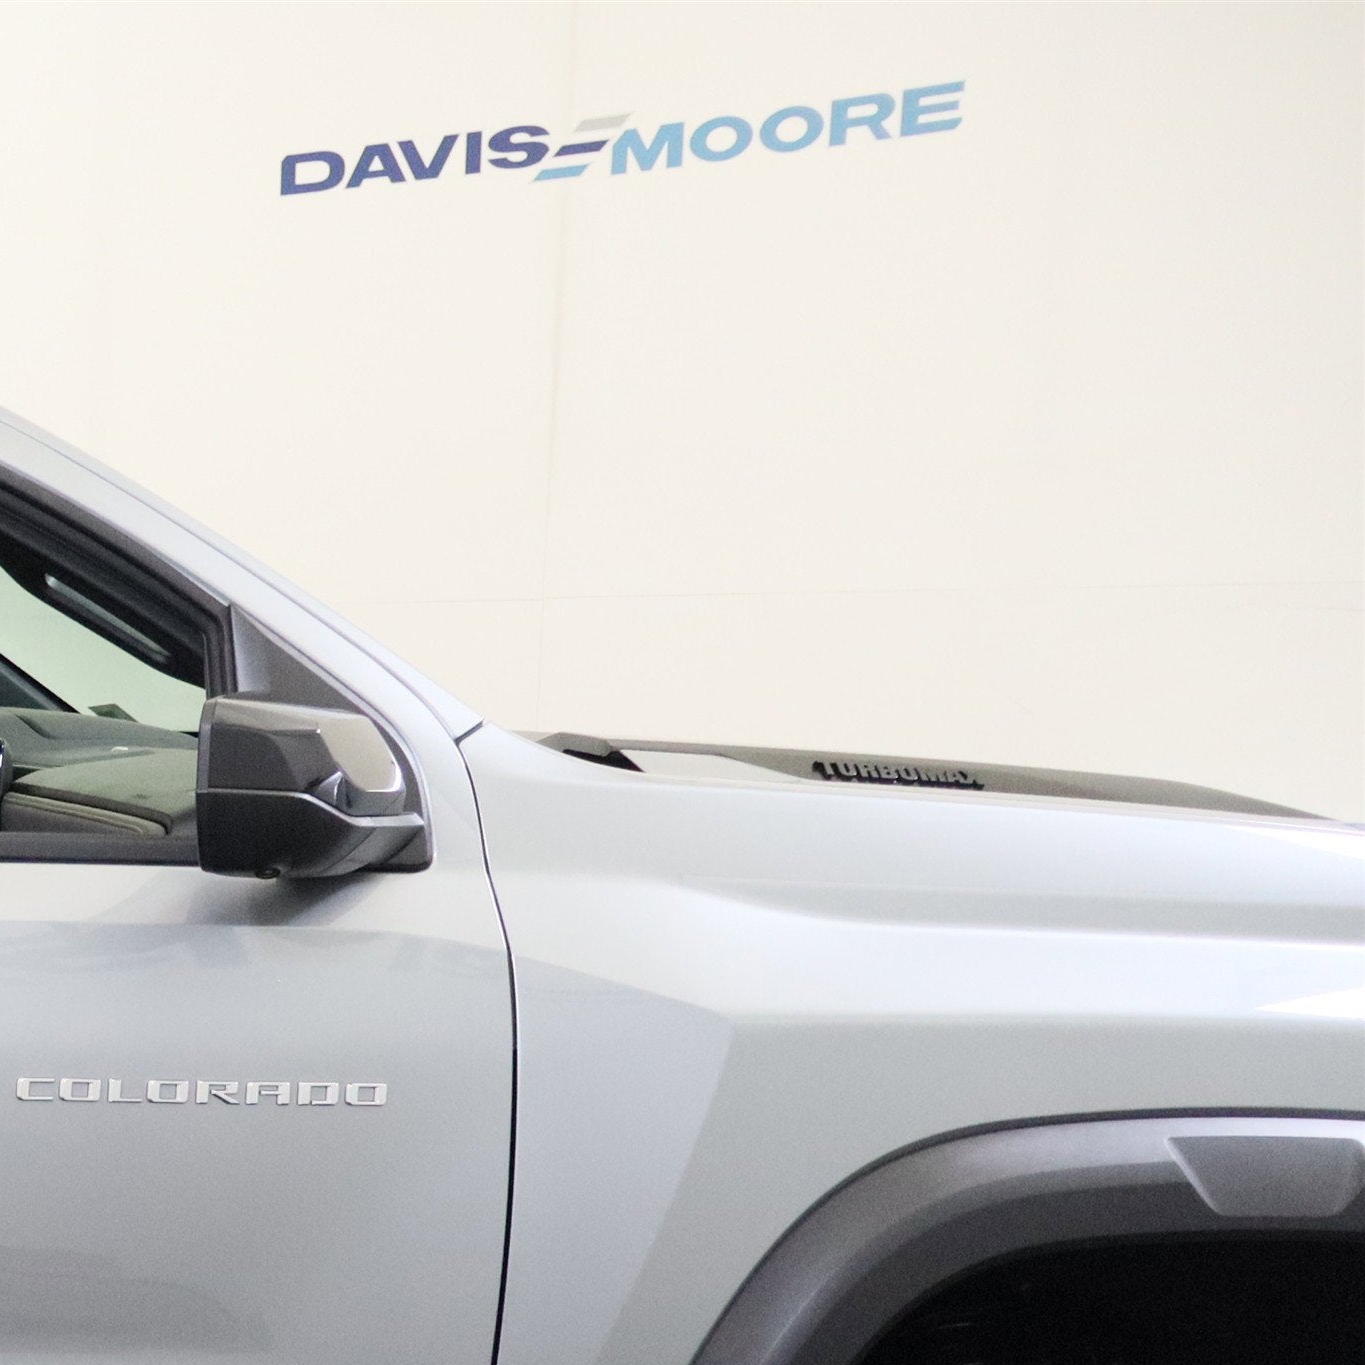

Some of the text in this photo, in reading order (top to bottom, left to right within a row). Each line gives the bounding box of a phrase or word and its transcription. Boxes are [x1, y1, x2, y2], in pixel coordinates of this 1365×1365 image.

[279, 78, 967, 197] DAVIS MOORE
[811, 760, 985, 791] TURBOMAX
[15, 1077, 389, 1107] COLORADO
